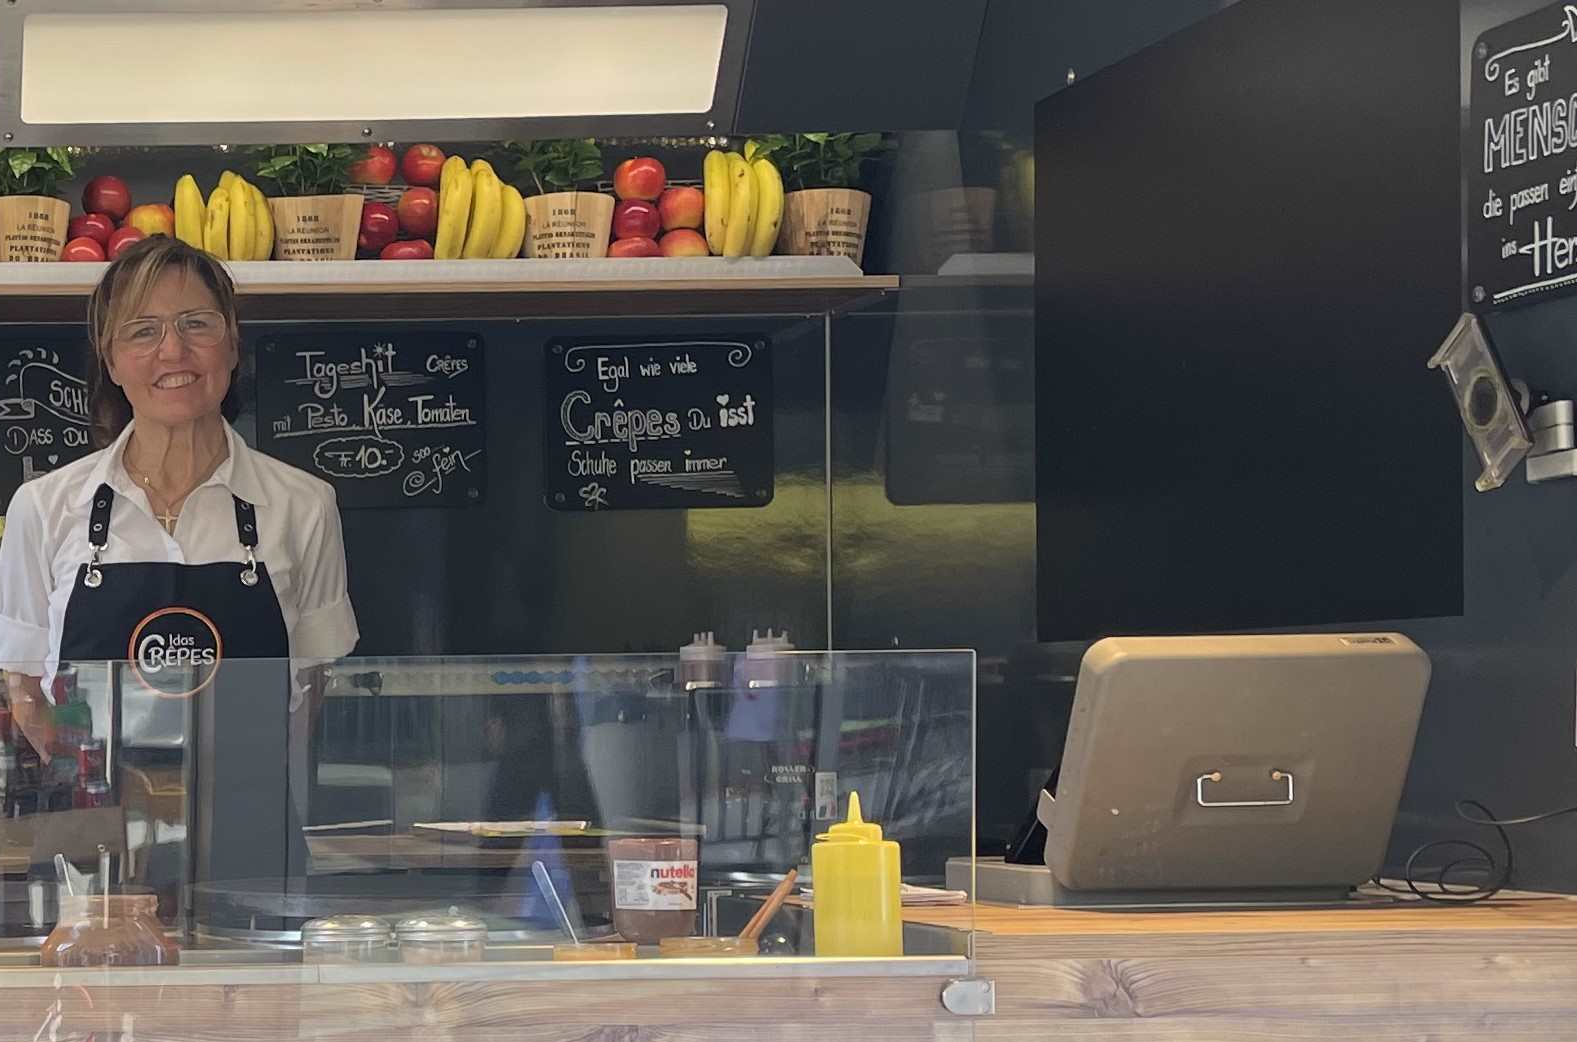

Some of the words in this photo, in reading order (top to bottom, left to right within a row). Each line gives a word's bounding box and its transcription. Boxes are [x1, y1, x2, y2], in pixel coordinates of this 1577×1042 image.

[1504, 68, 1520, 97] Es
[1526, 54, 1550, 101] gibt
[1483, 188, 1503, 218] die
[1510, 182, 1549, 226] passen
[1501, 237, 1518, 259] ins
[1522, 216, 1577, 277] Her
[295, 343, 396, 399] Tageshit
[597, 356, 630, 392] Egal
[639, 356, 662, 377] wie
[669, 353, 698, 375] viele
[273, 415, 291, 432] mit
[408, 395, 471, 425] Tomaten
[561, 390, 681, 451] Crêpes
[687, 407, 712, 431] Du
[715, 394, 756, 428] isst
[431, 446, 472, 494] fein
[567, 449, 617, 478] Schuhe
[630, 457, 673, 484] passen
[684, 449, 728, 472] immer
[138, 633, 215, 674] CRÊPES
[168, 633, 195, 647] Idas
